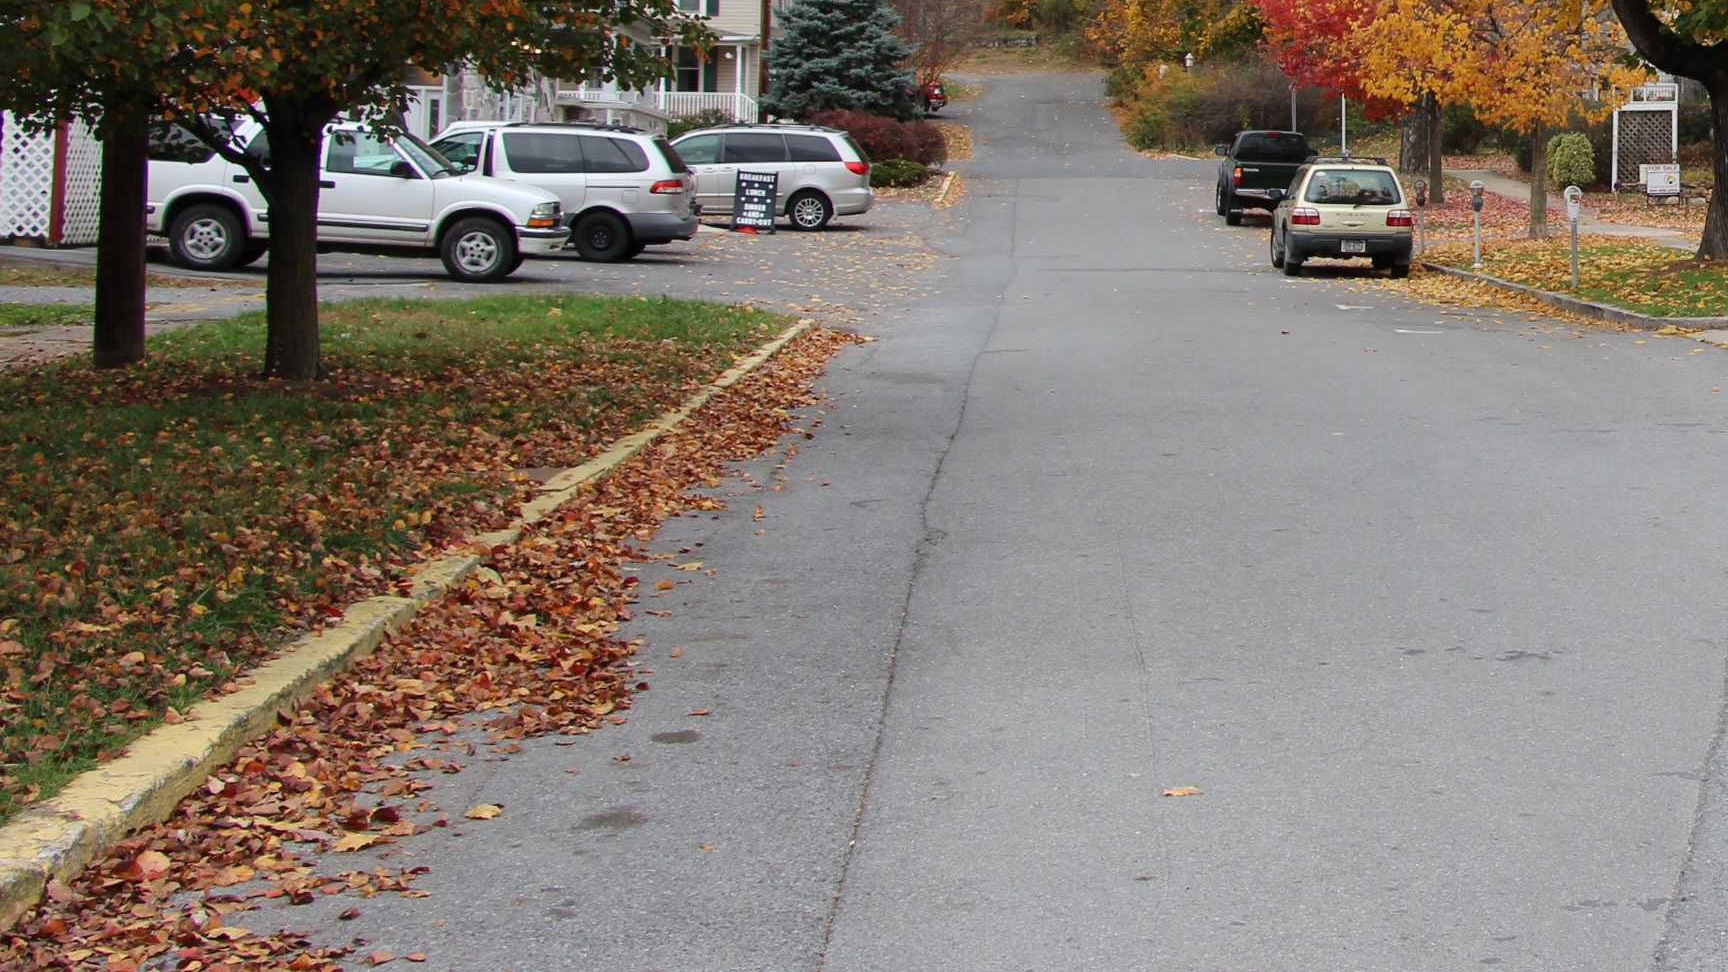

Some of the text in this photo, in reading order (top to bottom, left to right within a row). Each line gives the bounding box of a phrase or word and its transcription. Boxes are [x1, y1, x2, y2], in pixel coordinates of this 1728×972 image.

[739, 173, 775, 182] BREAKFAST
[744, 203, 766, 212] DINNER
[736, 217, 772, 226] CARRY-OUT
